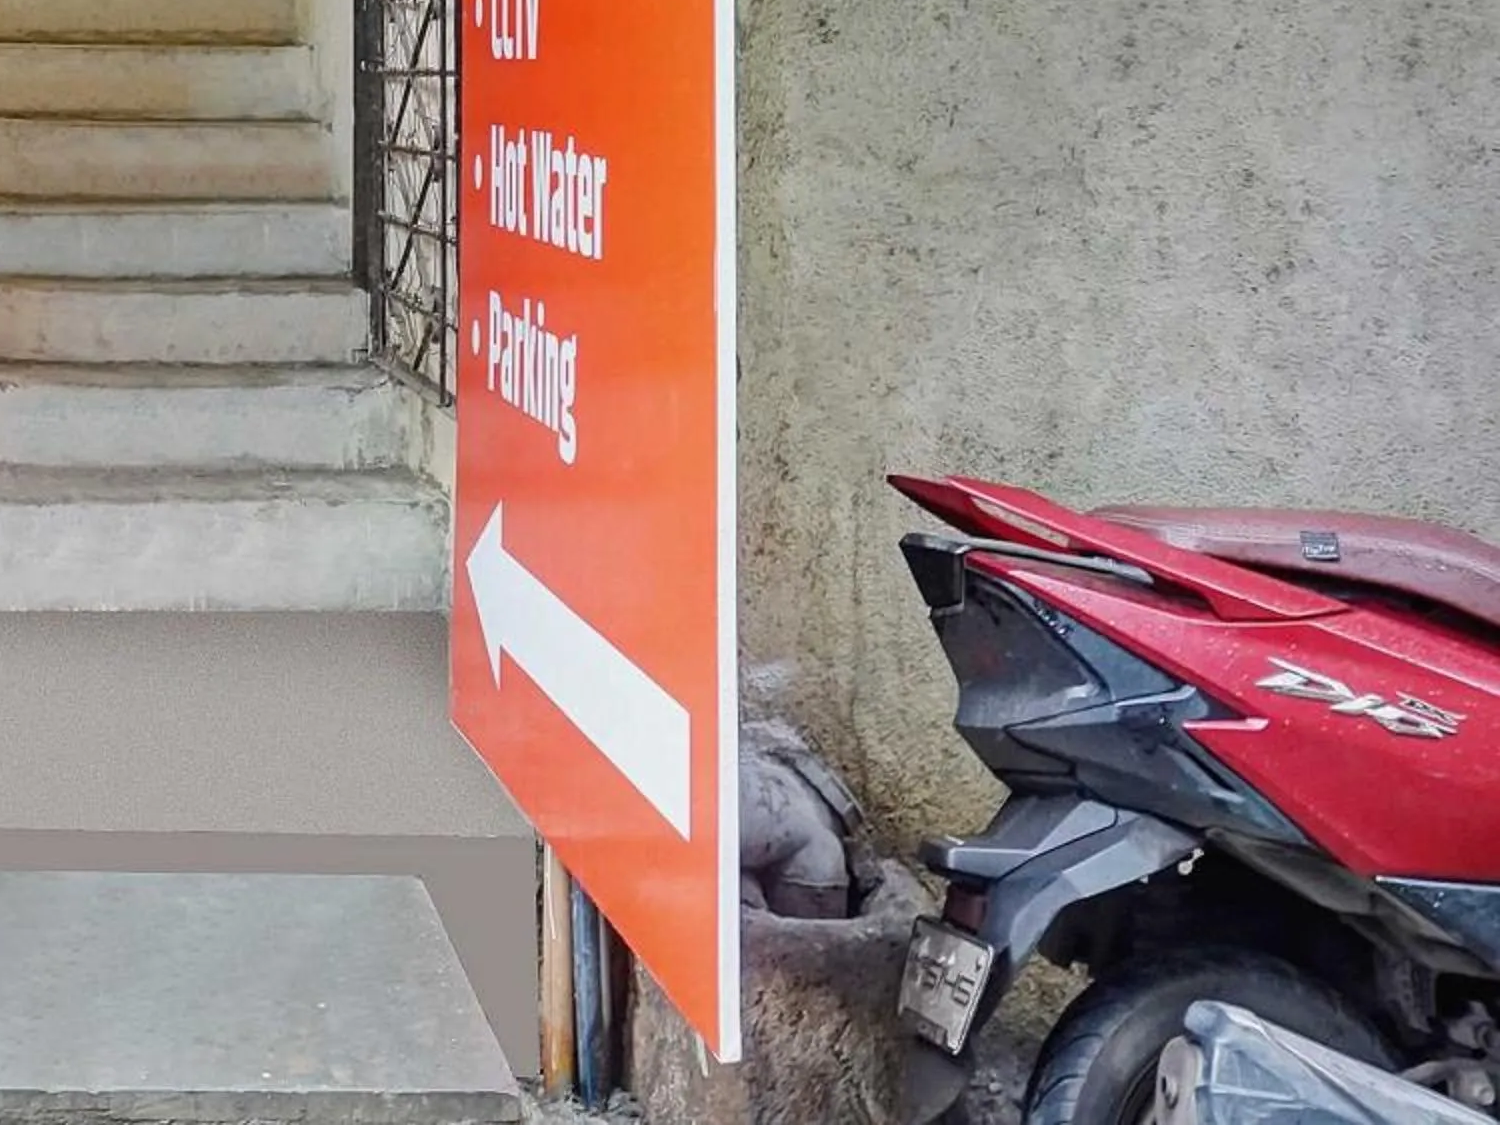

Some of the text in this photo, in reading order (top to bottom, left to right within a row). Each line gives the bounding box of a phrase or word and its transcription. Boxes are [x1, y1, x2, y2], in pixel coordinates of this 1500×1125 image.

[490, 124, 607, 260] Hot Water
[487, 289, 577, 465] Parking
